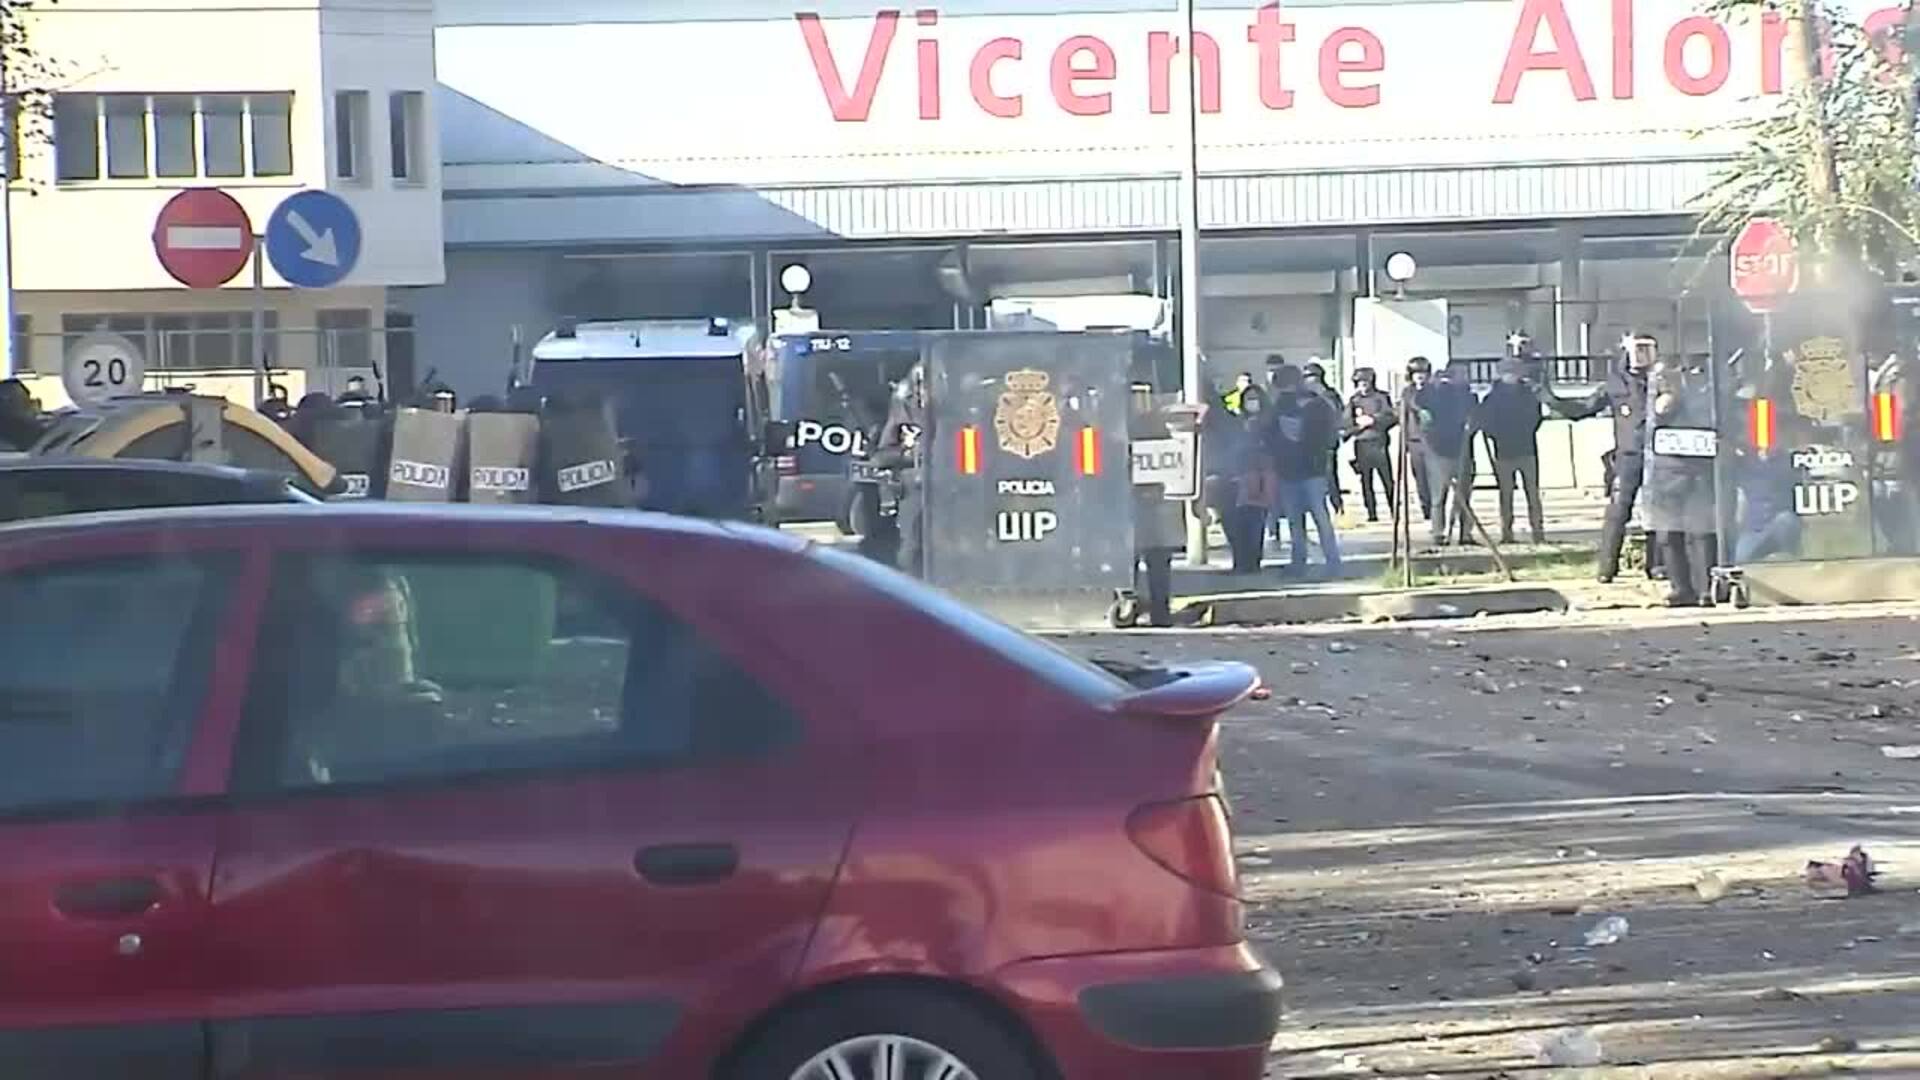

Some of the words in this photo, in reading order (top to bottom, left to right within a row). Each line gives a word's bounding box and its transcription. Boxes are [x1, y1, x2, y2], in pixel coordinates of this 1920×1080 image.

[795, 1, 1385, 121] Vicente
[83, 358, 126, 387] 20
[1793, 453, 1854, 468] POLICIA
[998, 480, 1055, 495] POLICIA
[1795, 483, 1858, 514] UIP
[999, 511, 1057, 540] UIP
